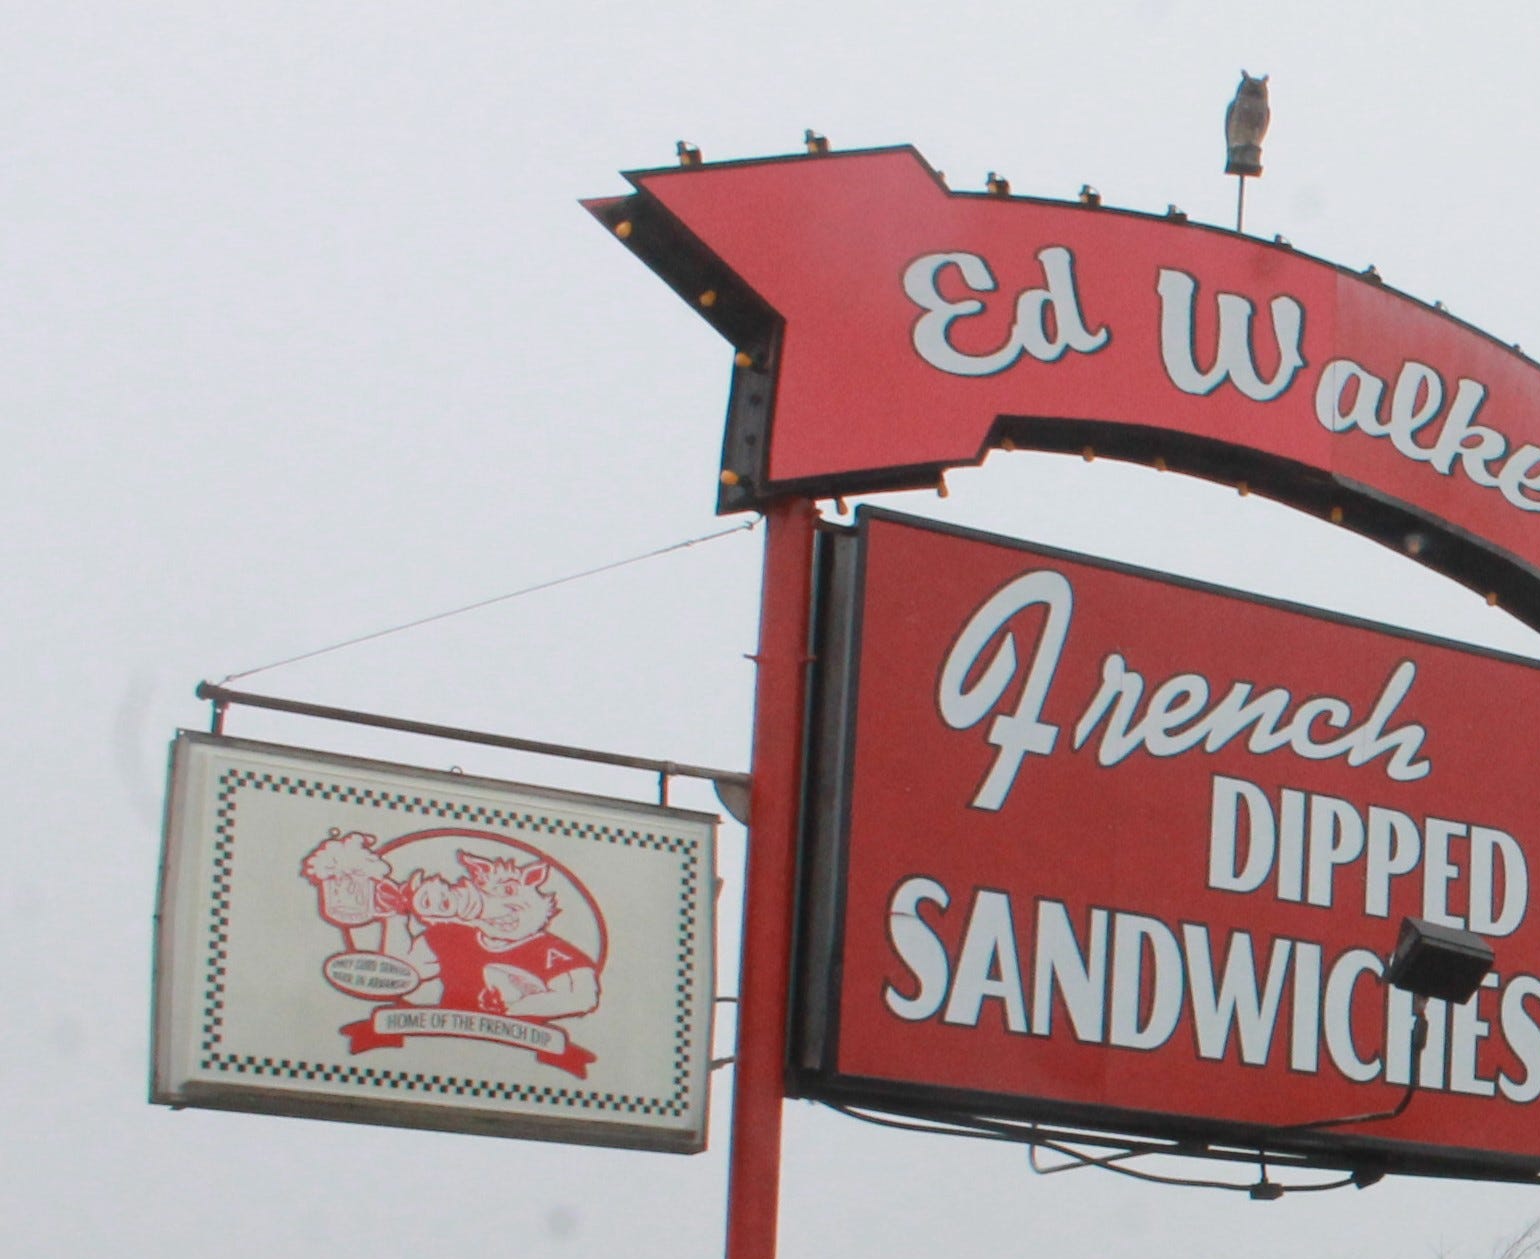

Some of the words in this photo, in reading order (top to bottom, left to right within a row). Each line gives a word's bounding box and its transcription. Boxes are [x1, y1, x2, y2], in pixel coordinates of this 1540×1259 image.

[902, 246, 1110, 377] Ed
[938, 569, 1431, 812] French
[1207, 773, 1529, 937] DIPPED
[386, 1012, 427, 1029] HOME
[431, 1012, 447, 1028] OF
[452, 1014, 475, 1031] THE
[479, 1016, 527, 1040] FRENCH
[531, 1028, 551, 1046] DIP
